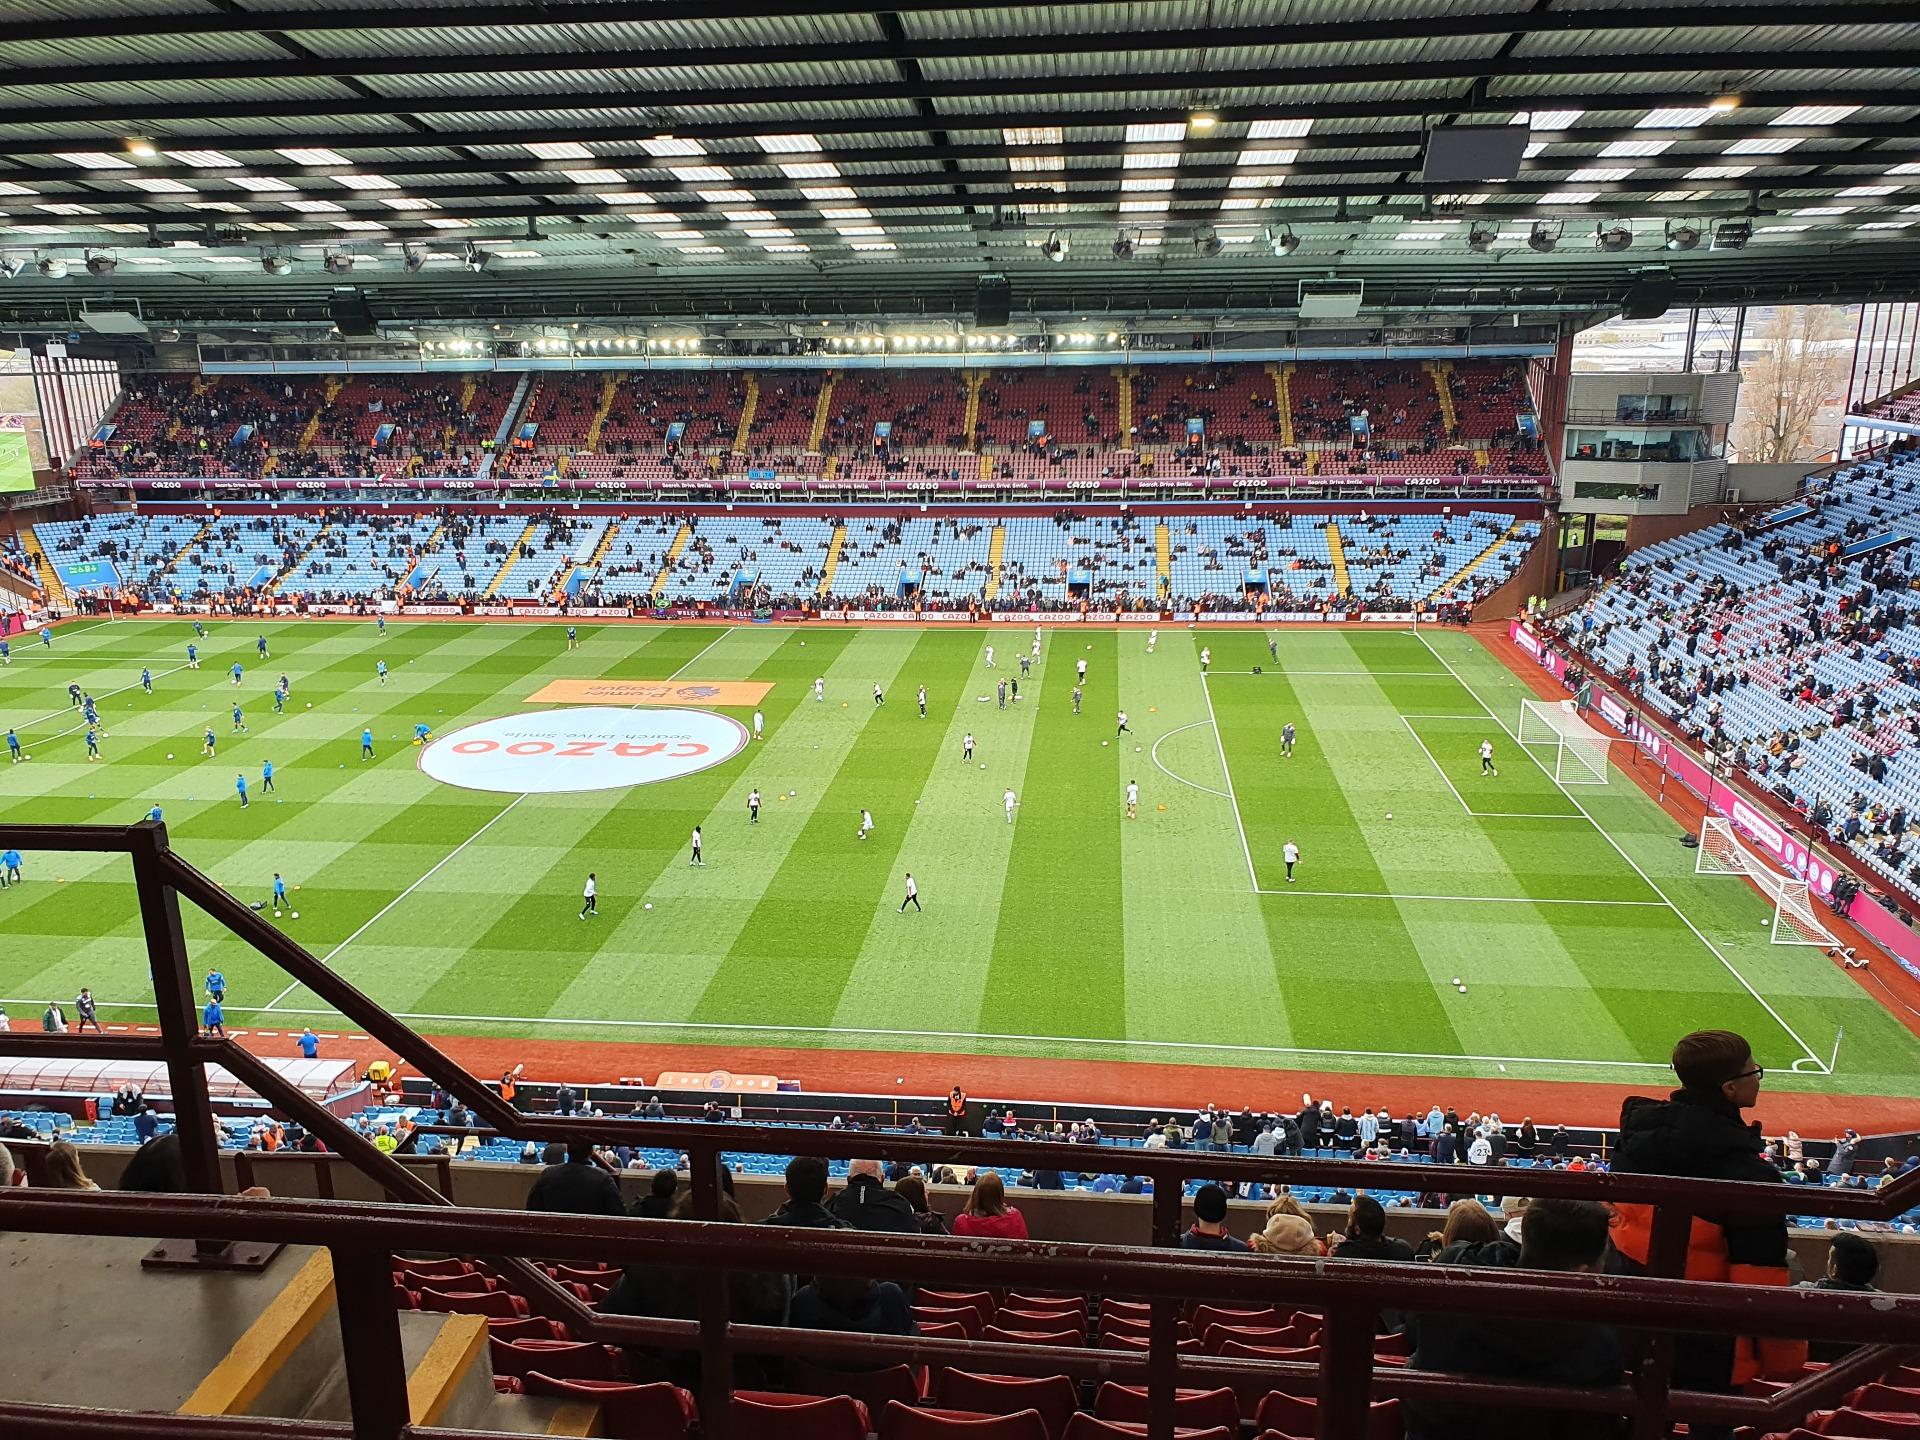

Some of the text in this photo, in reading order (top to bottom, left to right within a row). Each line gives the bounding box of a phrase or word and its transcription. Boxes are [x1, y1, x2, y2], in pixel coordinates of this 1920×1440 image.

[588, 685, 673, 693] League
[452, 740, 709, 757] CAZOO
[1476, 1148, 1488, 1157] 23
